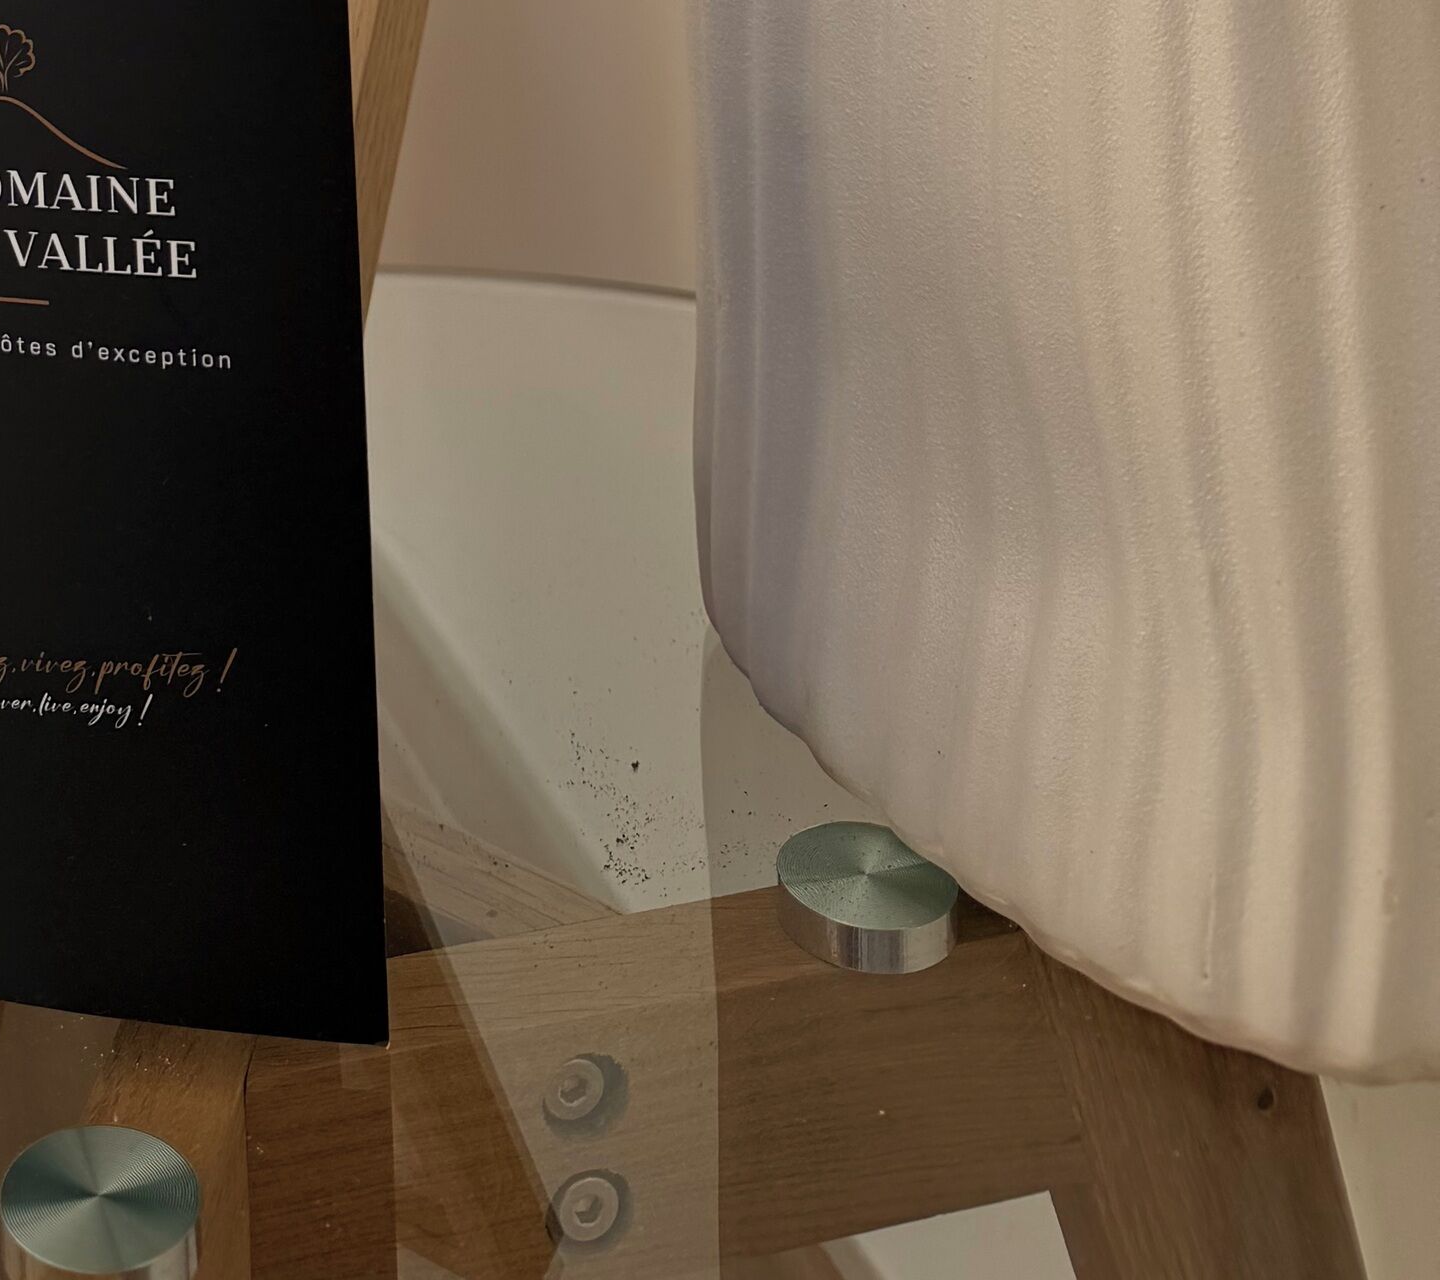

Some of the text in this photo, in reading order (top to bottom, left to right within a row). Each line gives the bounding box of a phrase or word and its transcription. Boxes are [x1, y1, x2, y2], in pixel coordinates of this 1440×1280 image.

[3, 228, 198, 279] VALLÉE
[70, 340, 232, 370] d'exception
[94, 651, 211, 699] profitez
[216, 647, 239, 694] !
[77, 699, 133, 730] enjoy
[137, 692, 155, 727] !
